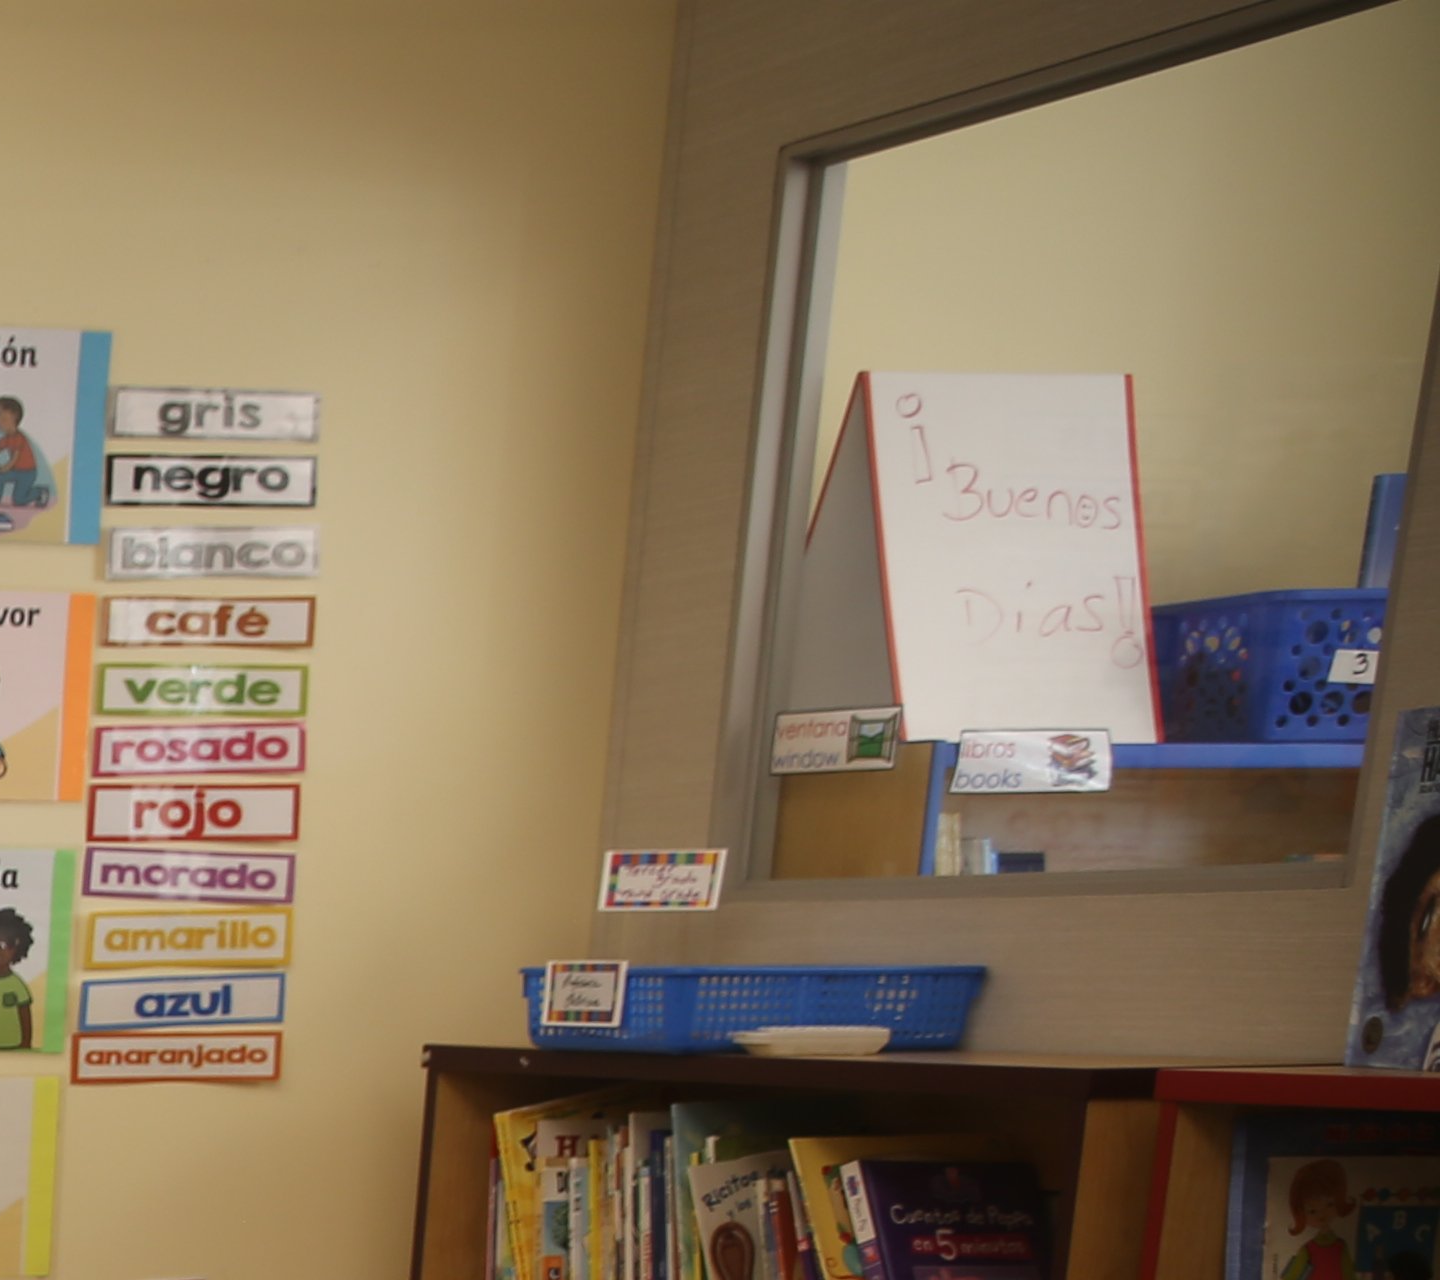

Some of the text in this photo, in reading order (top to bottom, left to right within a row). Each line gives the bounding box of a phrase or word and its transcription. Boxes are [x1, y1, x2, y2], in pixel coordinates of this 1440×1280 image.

[157, 393, 264, 437] gris
[131, 463, 291, 500] negro
[120, 536, 307, 571] blanco
[144, 604, 270, 638] café
[124, 673, 283, 706] verde
[776, 717, 849, 742] ventana
[109, 730, 290, 766] rosado
[773, 747, 841, 770] window
[960, 738, 1016, 760] libros
[954, 768, 1024, 789] books
[133, 788, 245, 840] rojo
[99, 862, 278, 892] morado
[103, 920, 278, 952] amarillo
[133, 983, 234, 1018] azul
[83, 1044, 270, 1069] anaranjado
